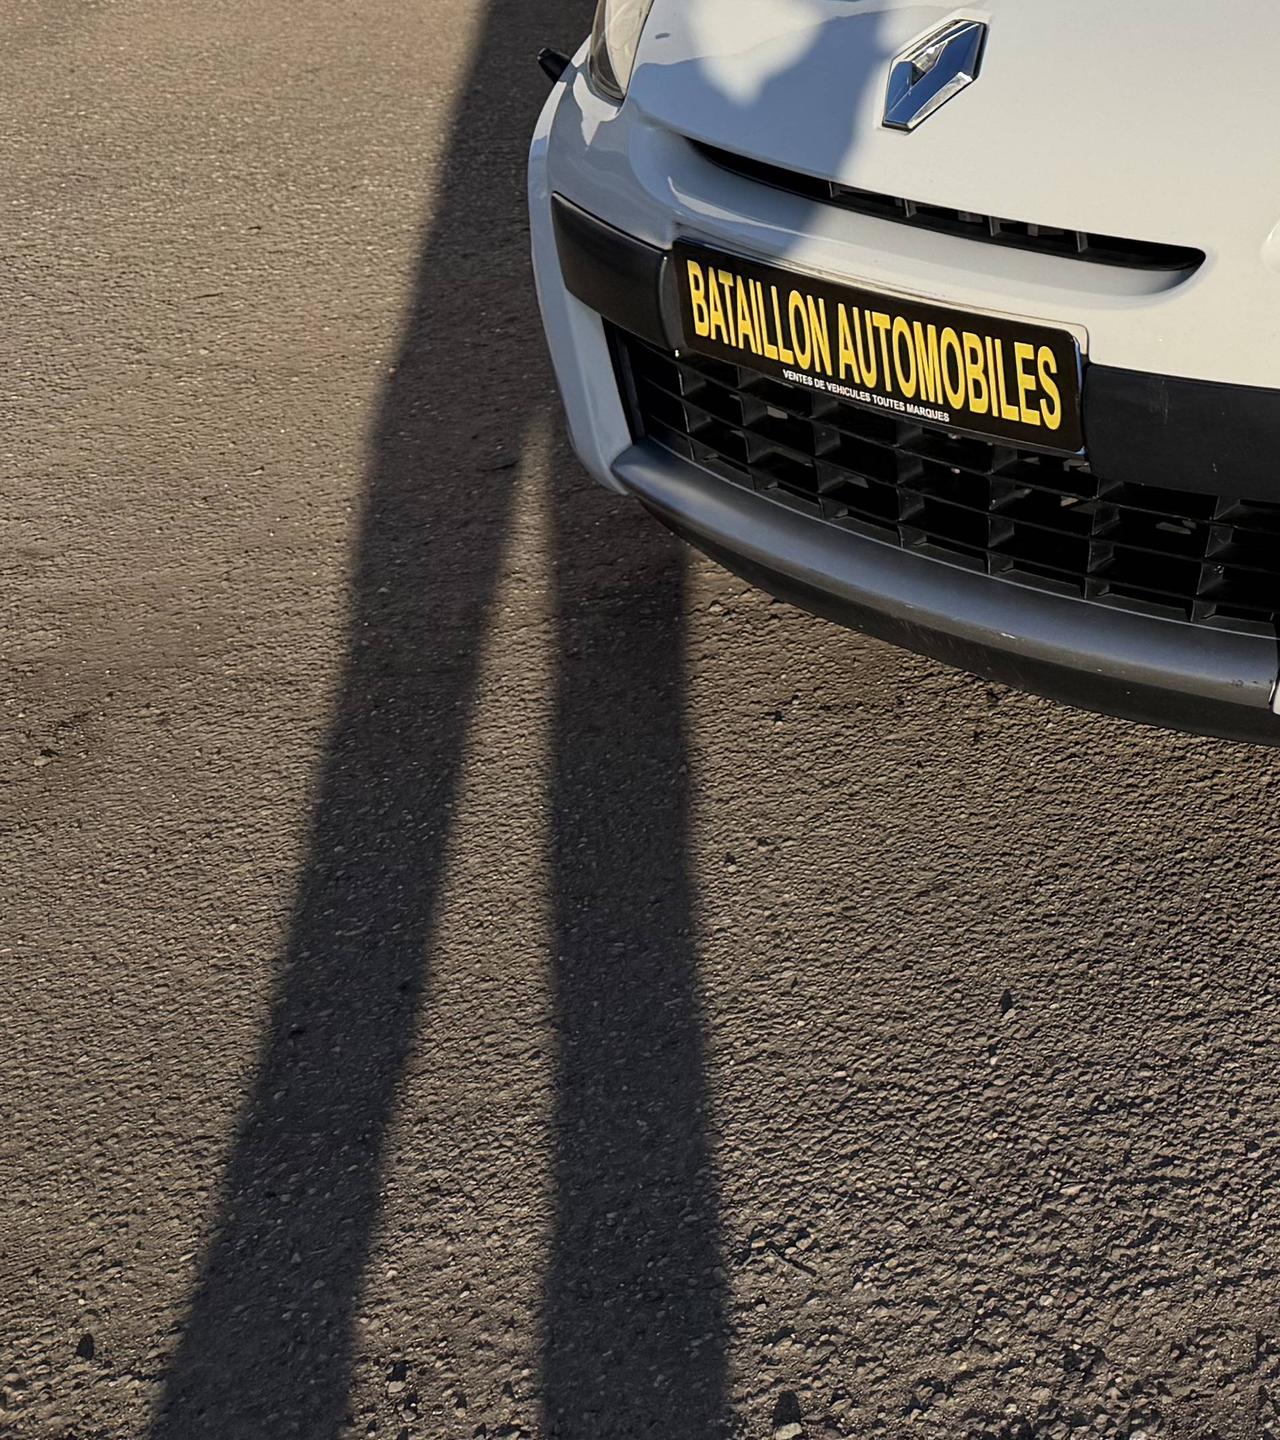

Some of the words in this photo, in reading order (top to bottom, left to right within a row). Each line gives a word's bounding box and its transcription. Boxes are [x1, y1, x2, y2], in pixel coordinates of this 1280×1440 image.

[686, 259, 833, 376] BATAILLON
[837, 303, 1062, 430] AUTOMOBILES
[782, 369, 813, 387] VENTES
[814, 379, 826, 390] DE
[826, 382, 871, 402] VEHICULES
[872, 394, 905, 411] TOUTES
[906, 403, 950, 422] MARQUES
